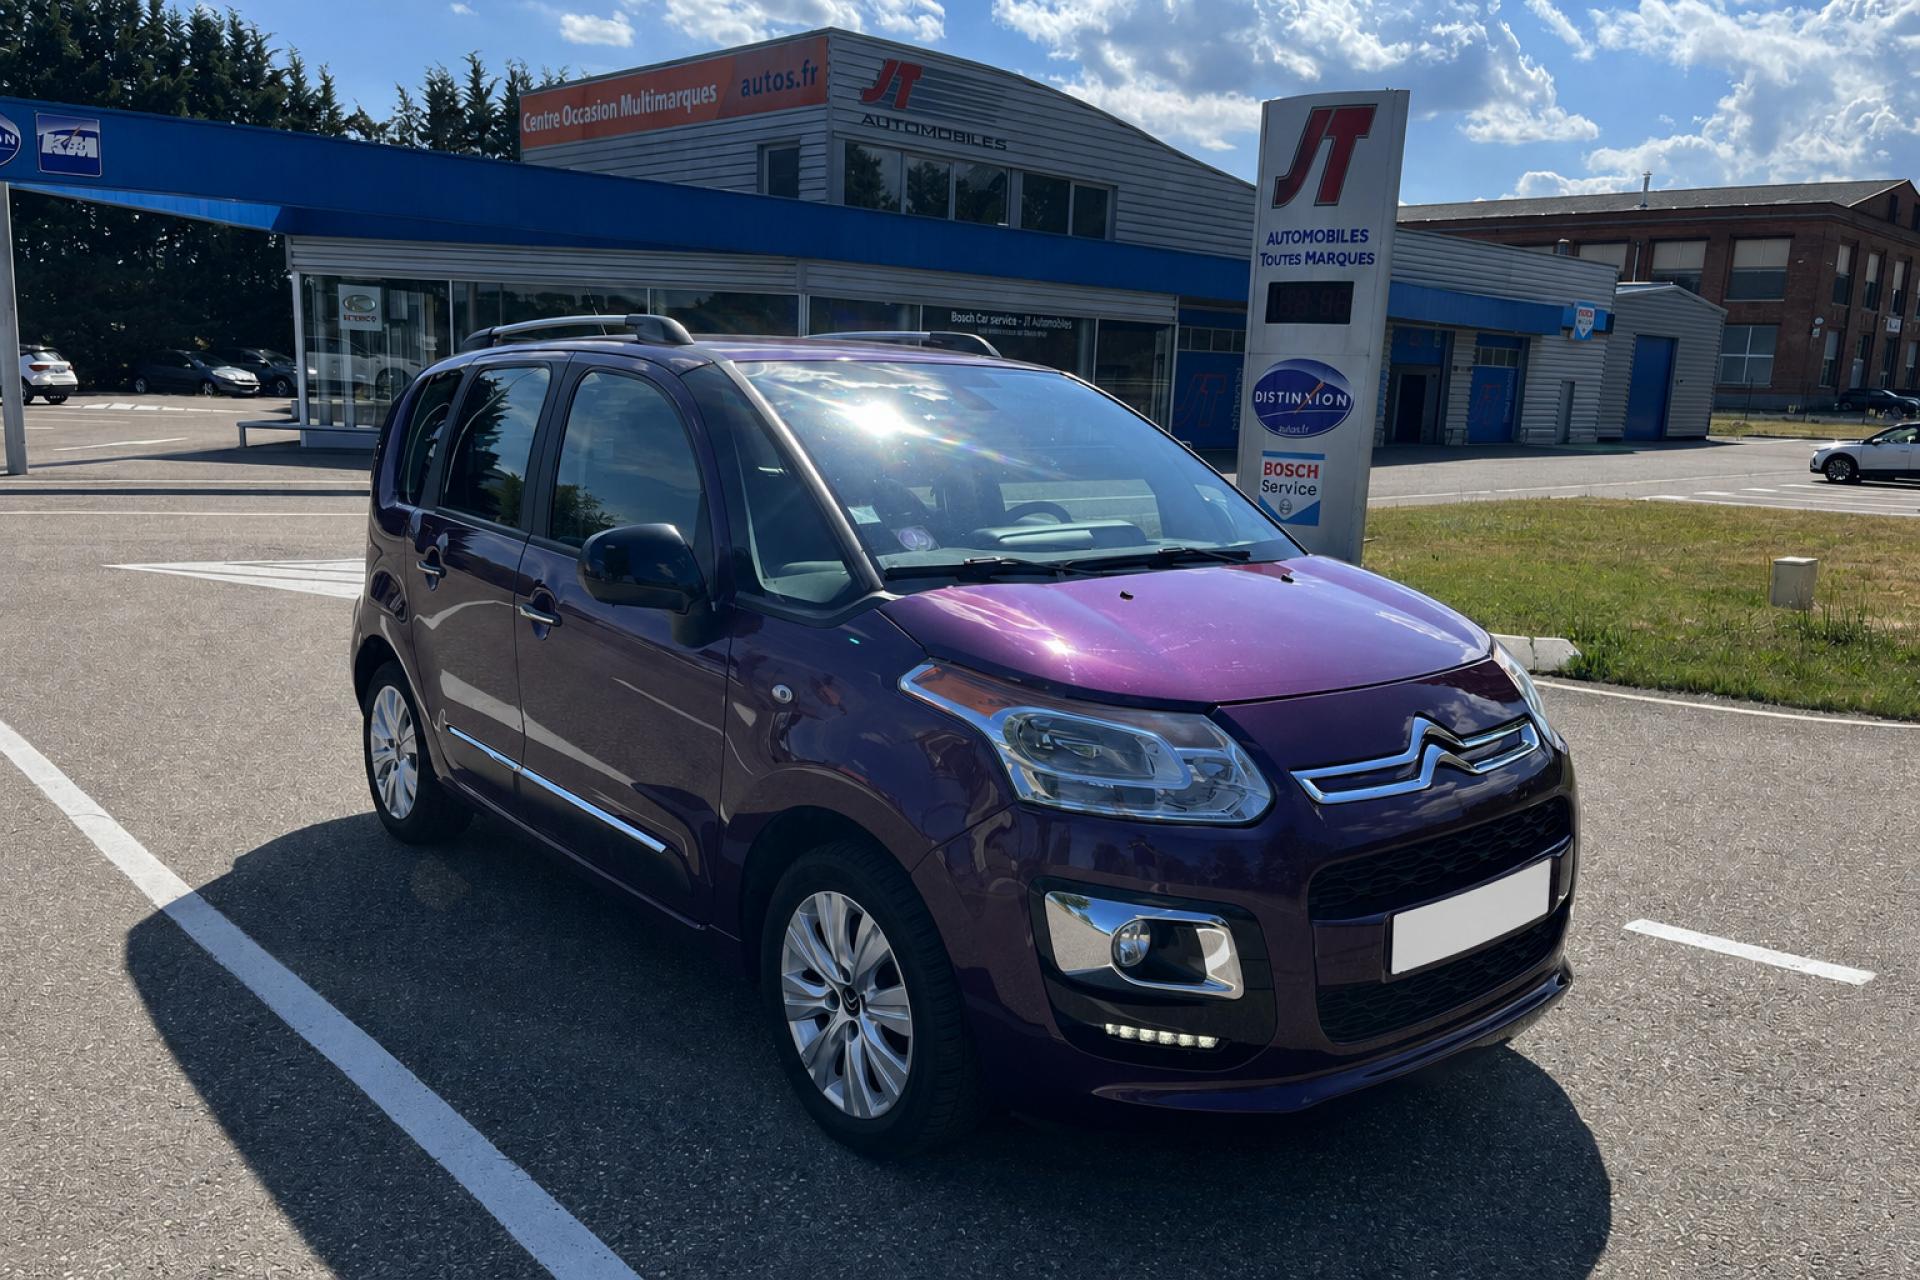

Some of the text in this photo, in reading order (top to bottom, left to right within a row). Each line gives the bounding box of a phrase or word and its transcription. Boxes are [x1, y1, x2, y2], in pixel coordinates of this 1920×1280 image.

[741, 59, 819, 97] autos.fr
[860, 58, 923, 109] JT
[523, 84, 717, 133] Centre Occasion Multimarques
[862, 113, 1008, 150] AUTOMOBILES
[1272, 104, 1378, 209] JT
[1266, 229, 1369, 246] AUTOMOBILES
[951, 311, 975, 324] Bosch
[1262, 479, 1317, 496] Service
[1264, 461, 1319, 479] BOSCH
